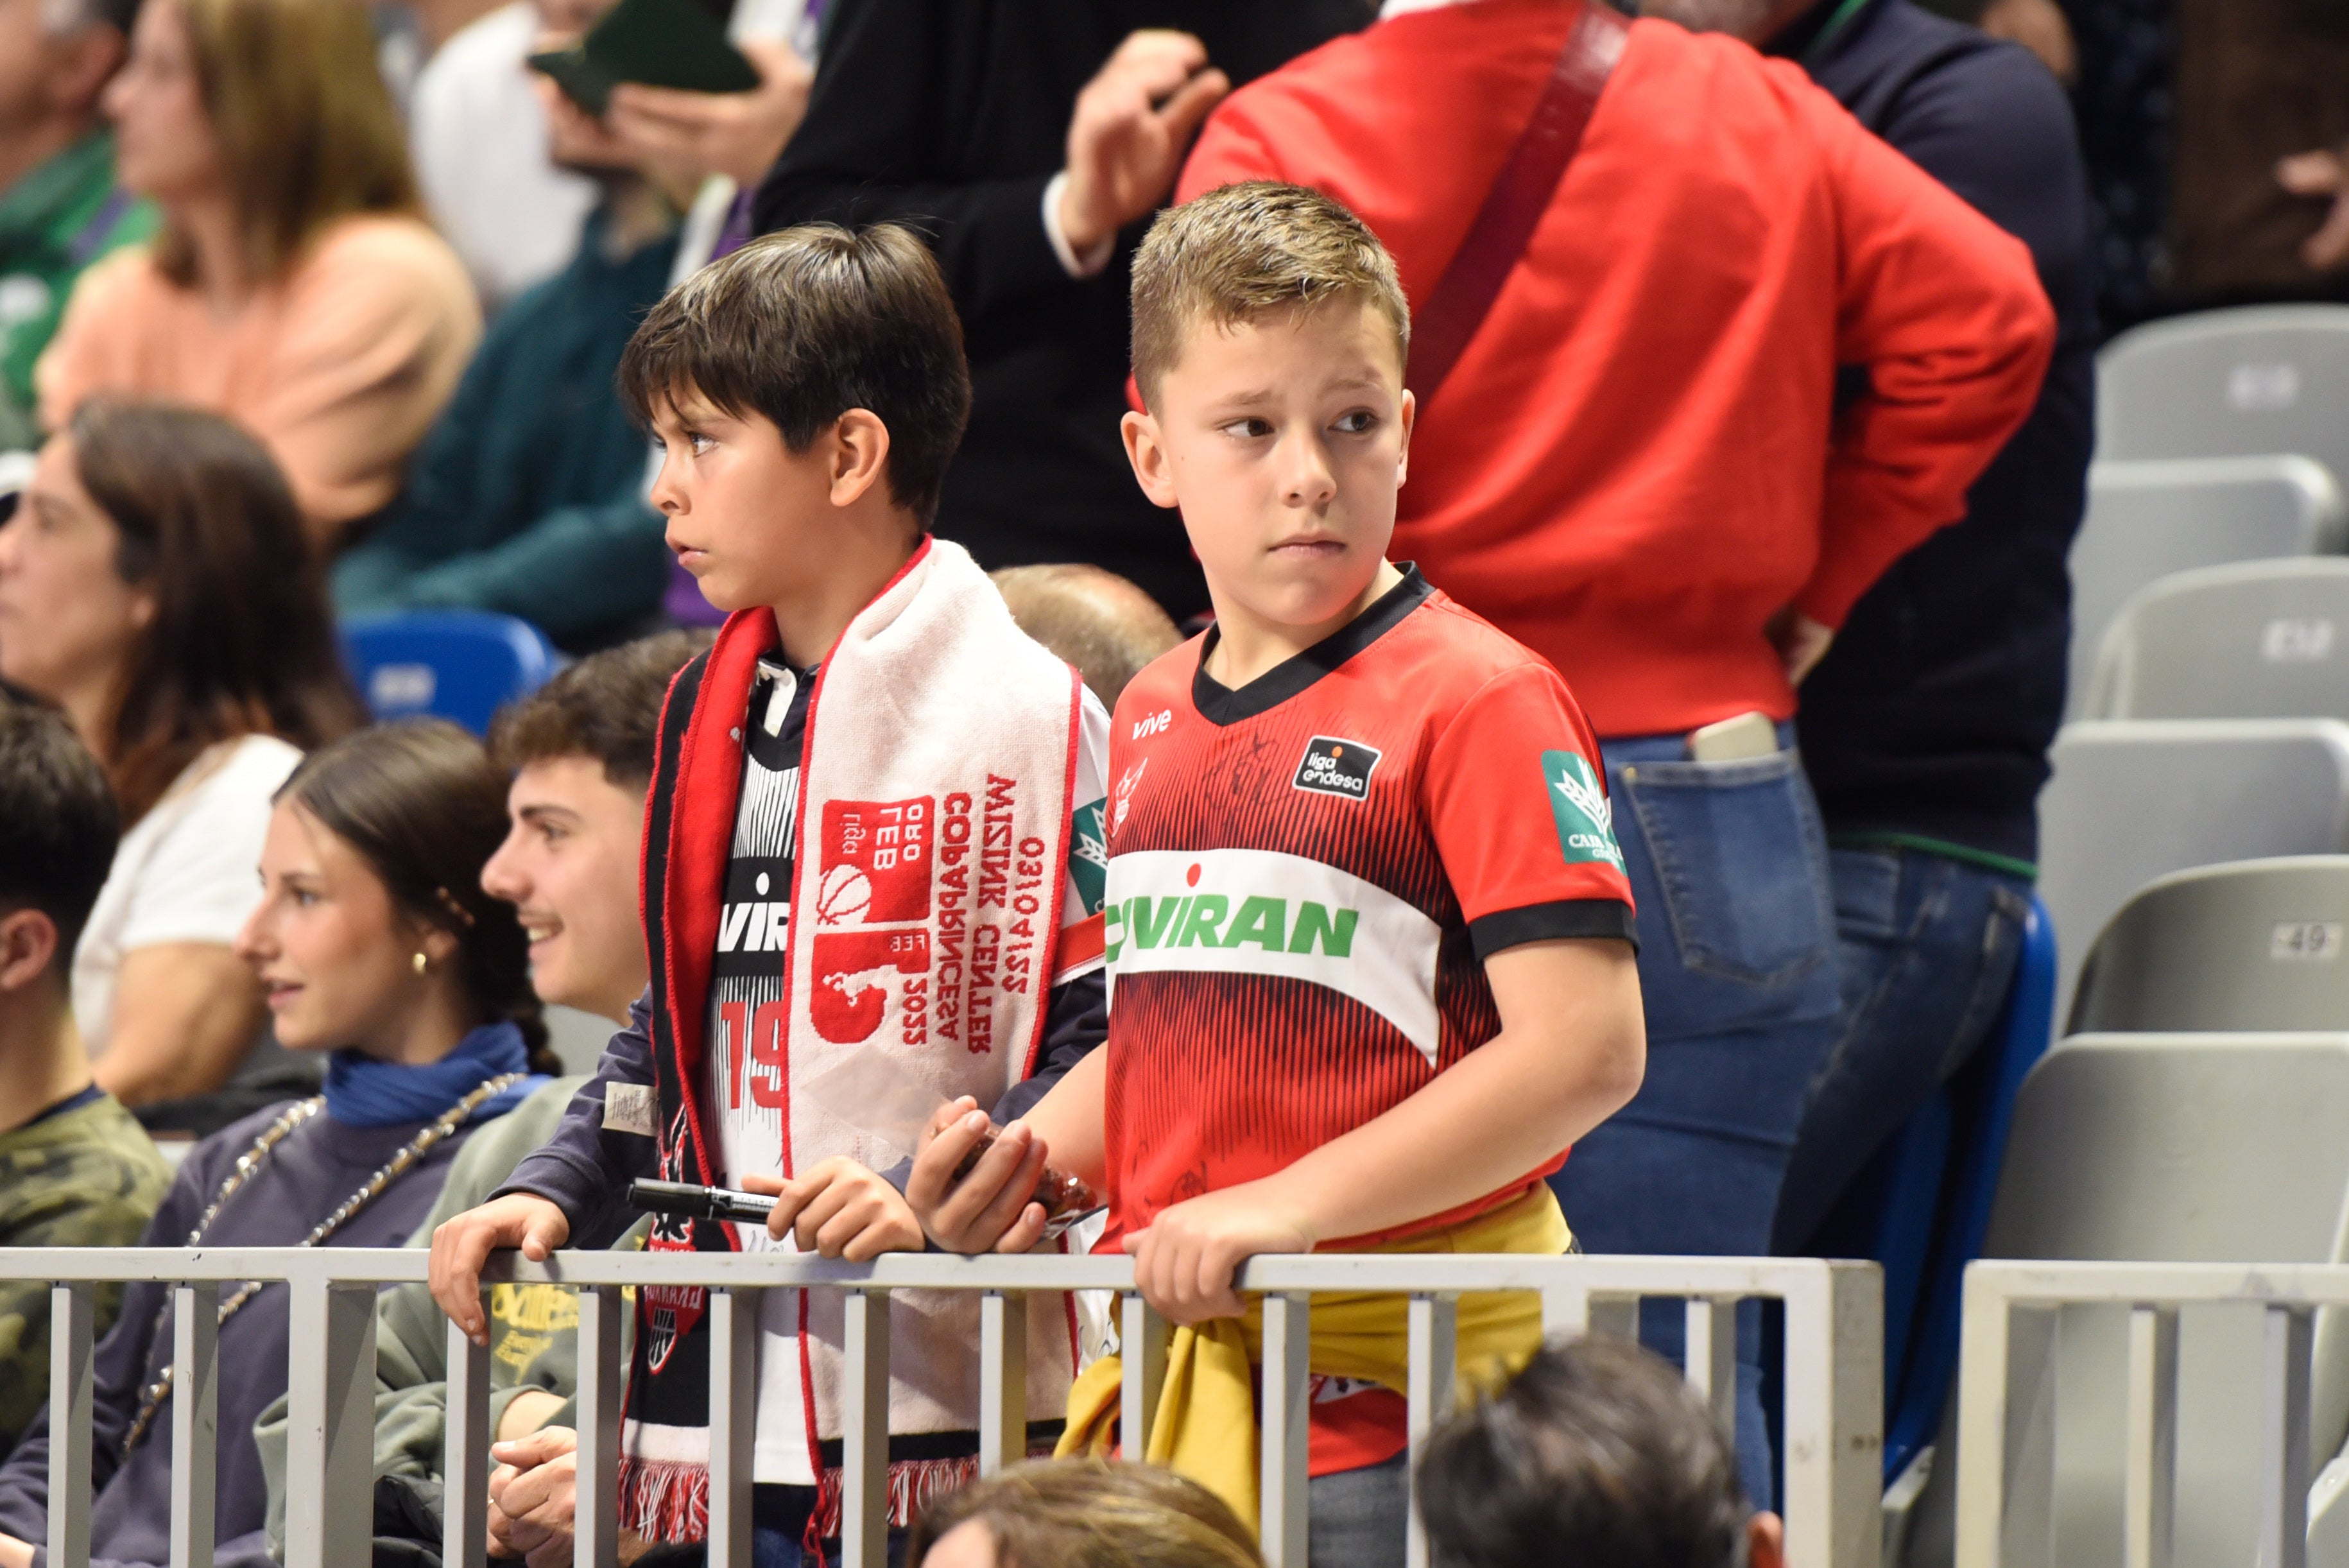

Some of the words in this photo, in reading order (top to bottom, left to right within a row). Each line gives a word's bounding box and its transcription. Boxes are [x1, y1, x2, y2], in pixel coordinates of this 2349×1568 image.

[1132, 709, 1171, 740] vive
[1307, 752, 1337, 771] liga
[1302, 770, 1364, 792] endesa
